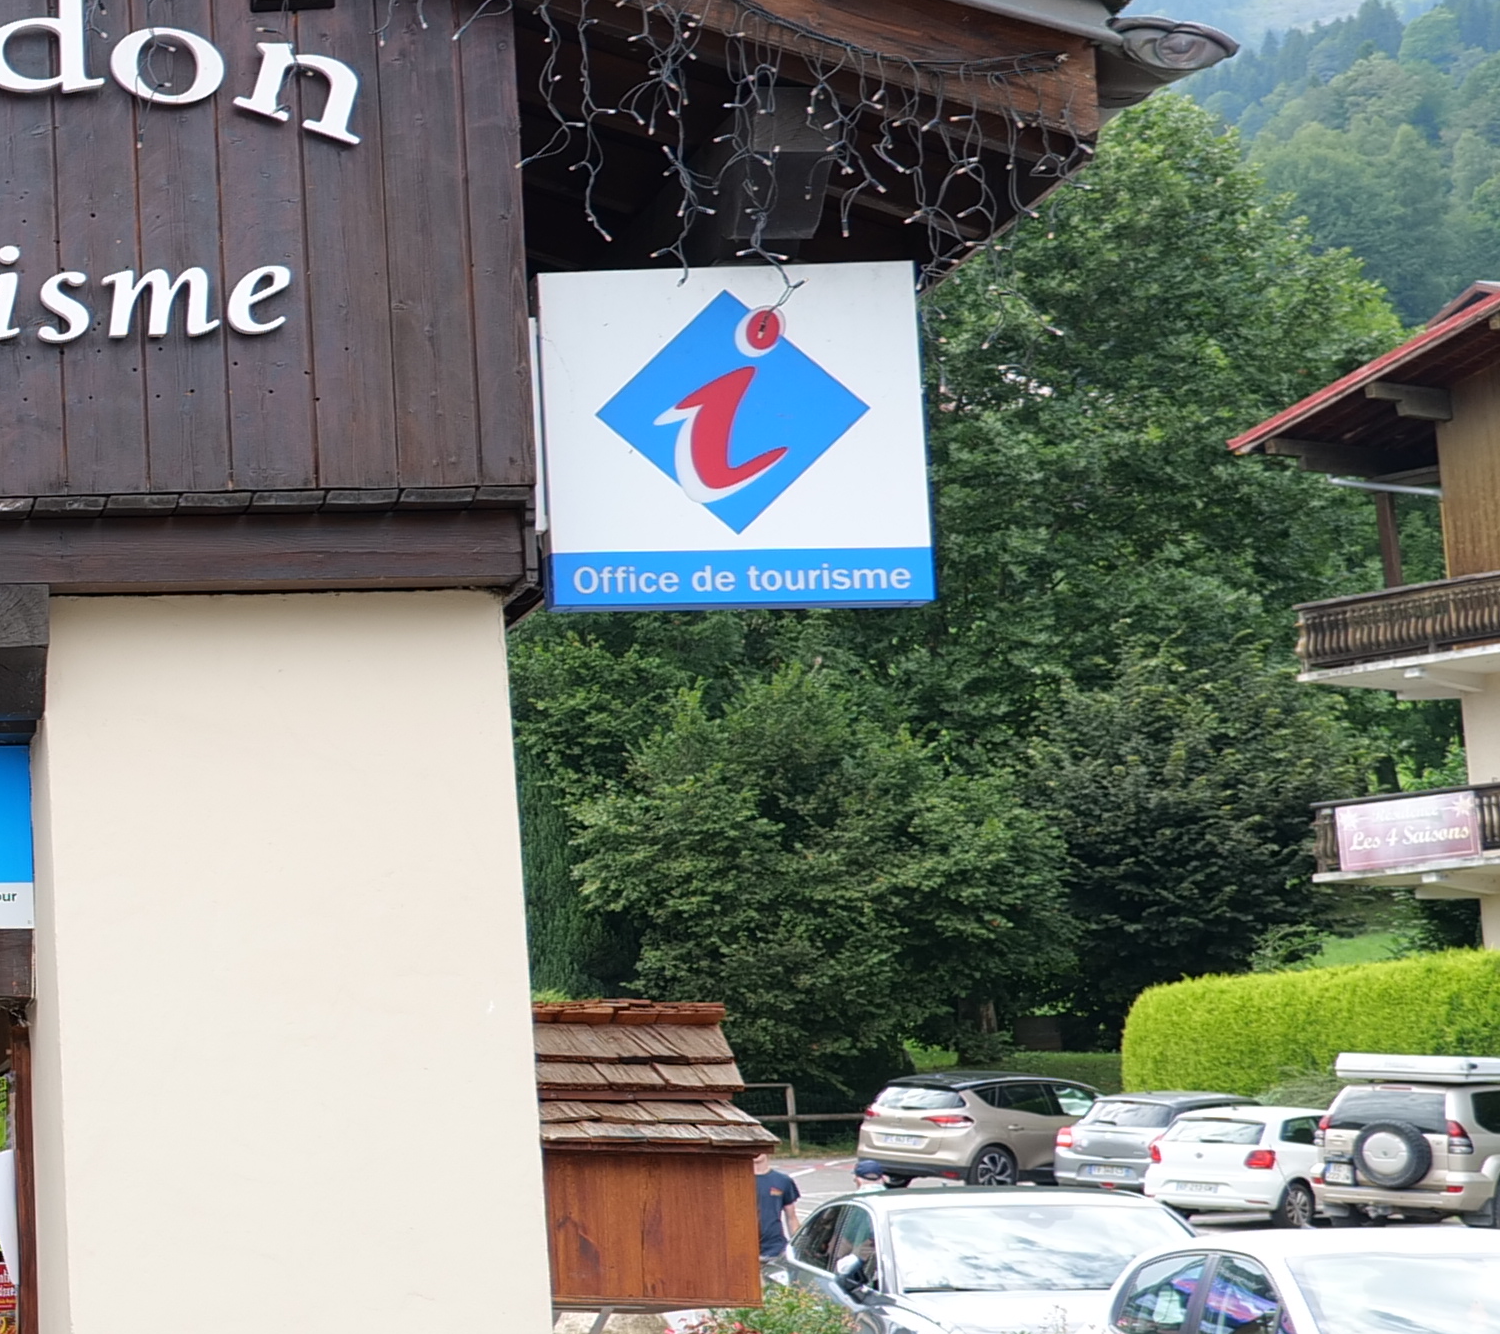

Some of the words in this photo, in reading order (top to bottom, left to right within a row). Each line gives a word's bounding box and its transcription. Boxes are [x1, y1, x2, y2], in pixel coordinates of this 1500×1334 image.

[573, 565, 680, 594] Office
[691, 564, 737, 592] de
[748, 563, 912, 592] tourisme
[1350, 831, 1381, 850] Les
[1385, 827, 1399, 847] 4
[1402, 825, 1470, 845] Saisons
